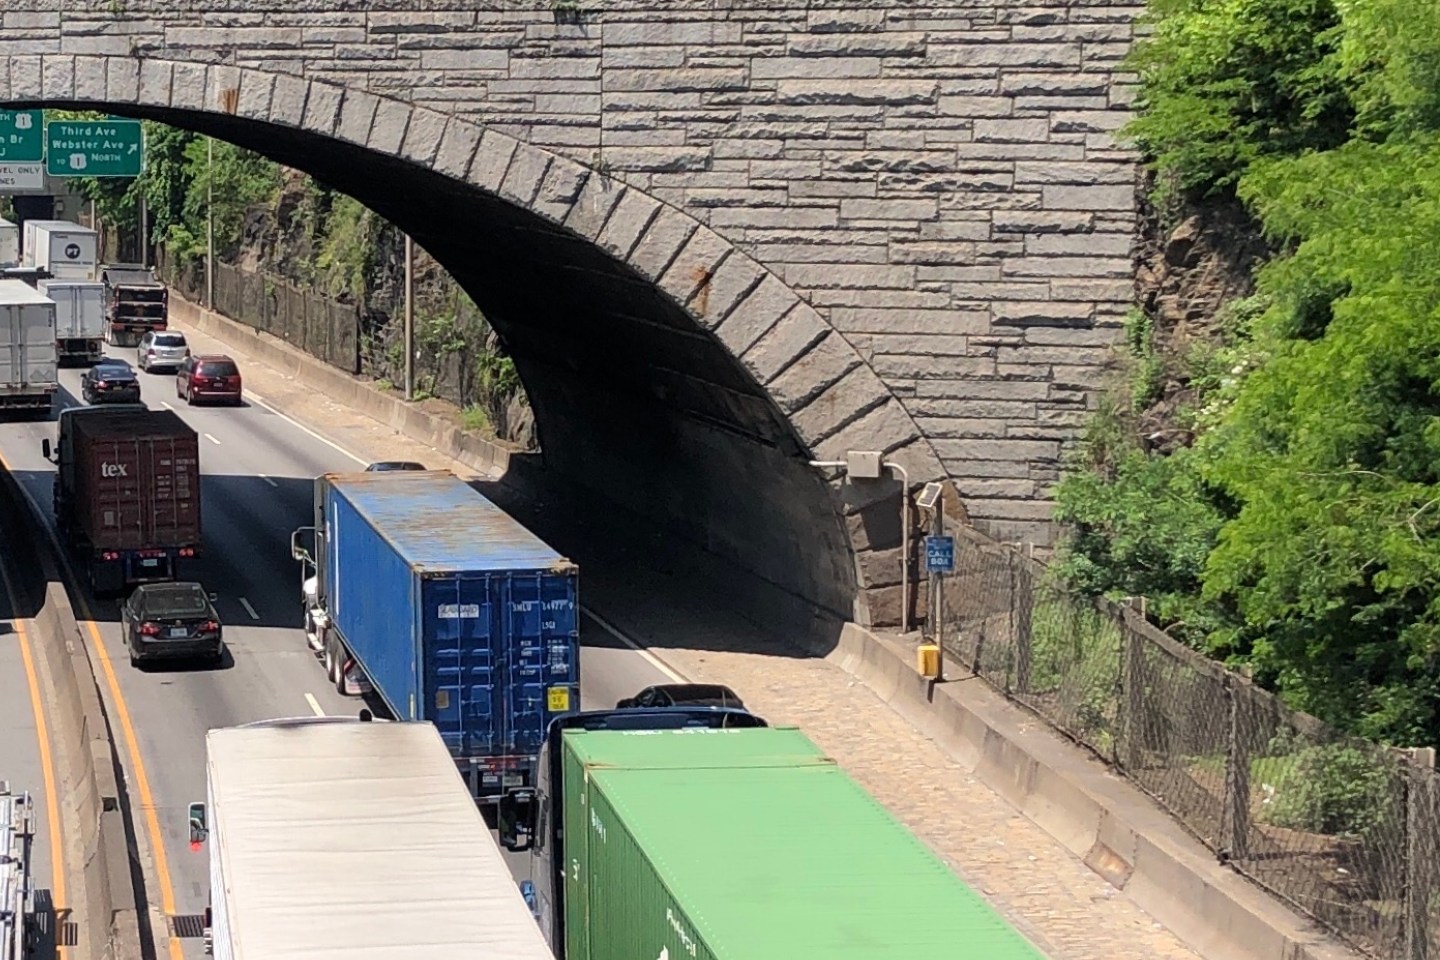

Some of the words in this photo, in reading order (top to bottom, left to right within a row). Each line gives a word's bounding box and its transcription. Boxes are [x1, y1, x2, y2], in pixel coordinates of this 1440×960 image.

[61, 126, 92, 136] Third
[95, 126, 117, 136] Ave
[10, 134, 23, 144] Br
[52, 140, 99, 149] Webster
[102, 140, 124, 149] Ave
[91, 153, 121, 162] NORTH
[18, 166, 40, 174] ONLY
[101, 461, 127, 477] tex
